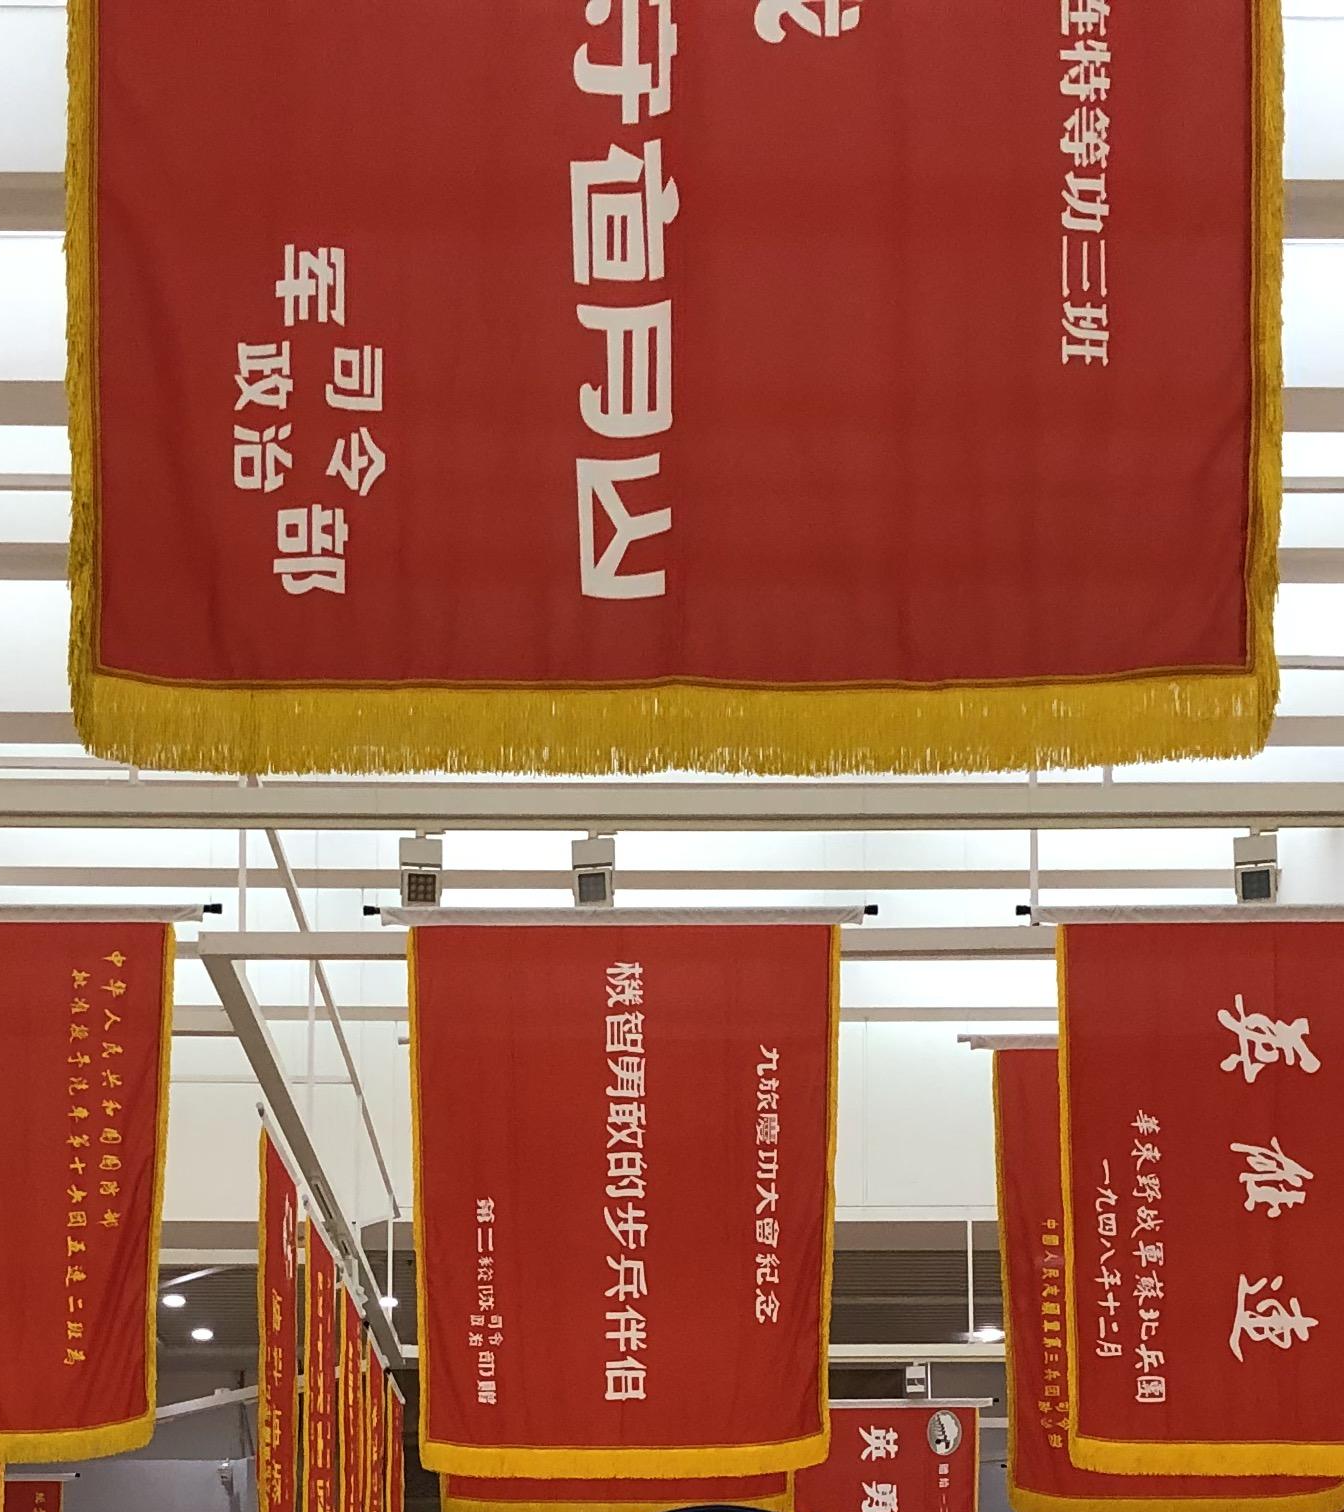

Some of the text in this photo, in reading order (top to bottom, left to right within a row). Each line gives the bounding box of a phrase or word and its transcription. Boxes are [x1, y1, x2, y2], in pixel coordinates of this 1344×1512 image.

[1095, 1158, 1125, 1360] 一九四八年十二月
